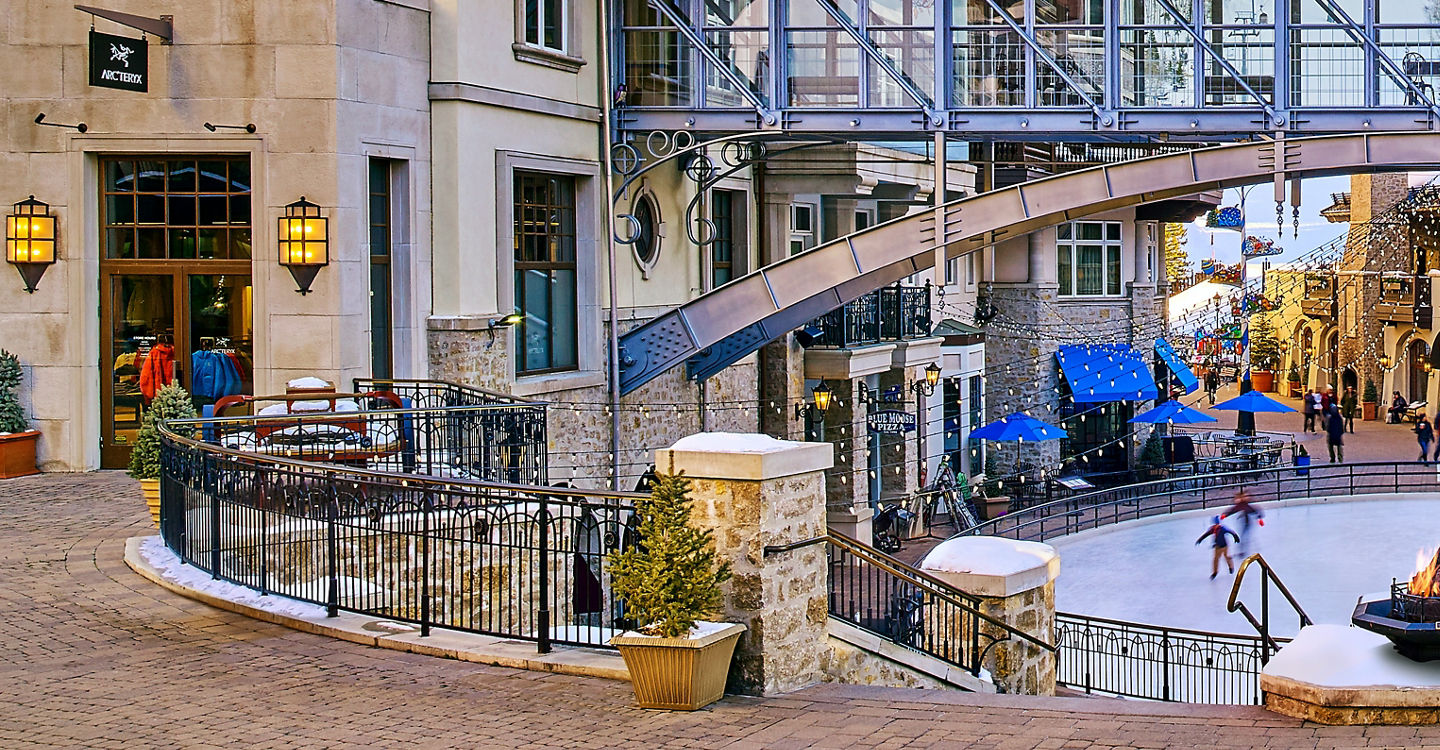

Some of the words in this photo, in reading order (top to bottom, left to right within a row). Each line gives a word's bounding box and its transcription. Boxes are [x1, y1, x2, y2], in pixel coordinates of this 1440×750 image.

[868, 413, 888, 424] BLUE
[889, 412, 914, 424] MOOSE
[877, 423, 905, 431] PIZZA
